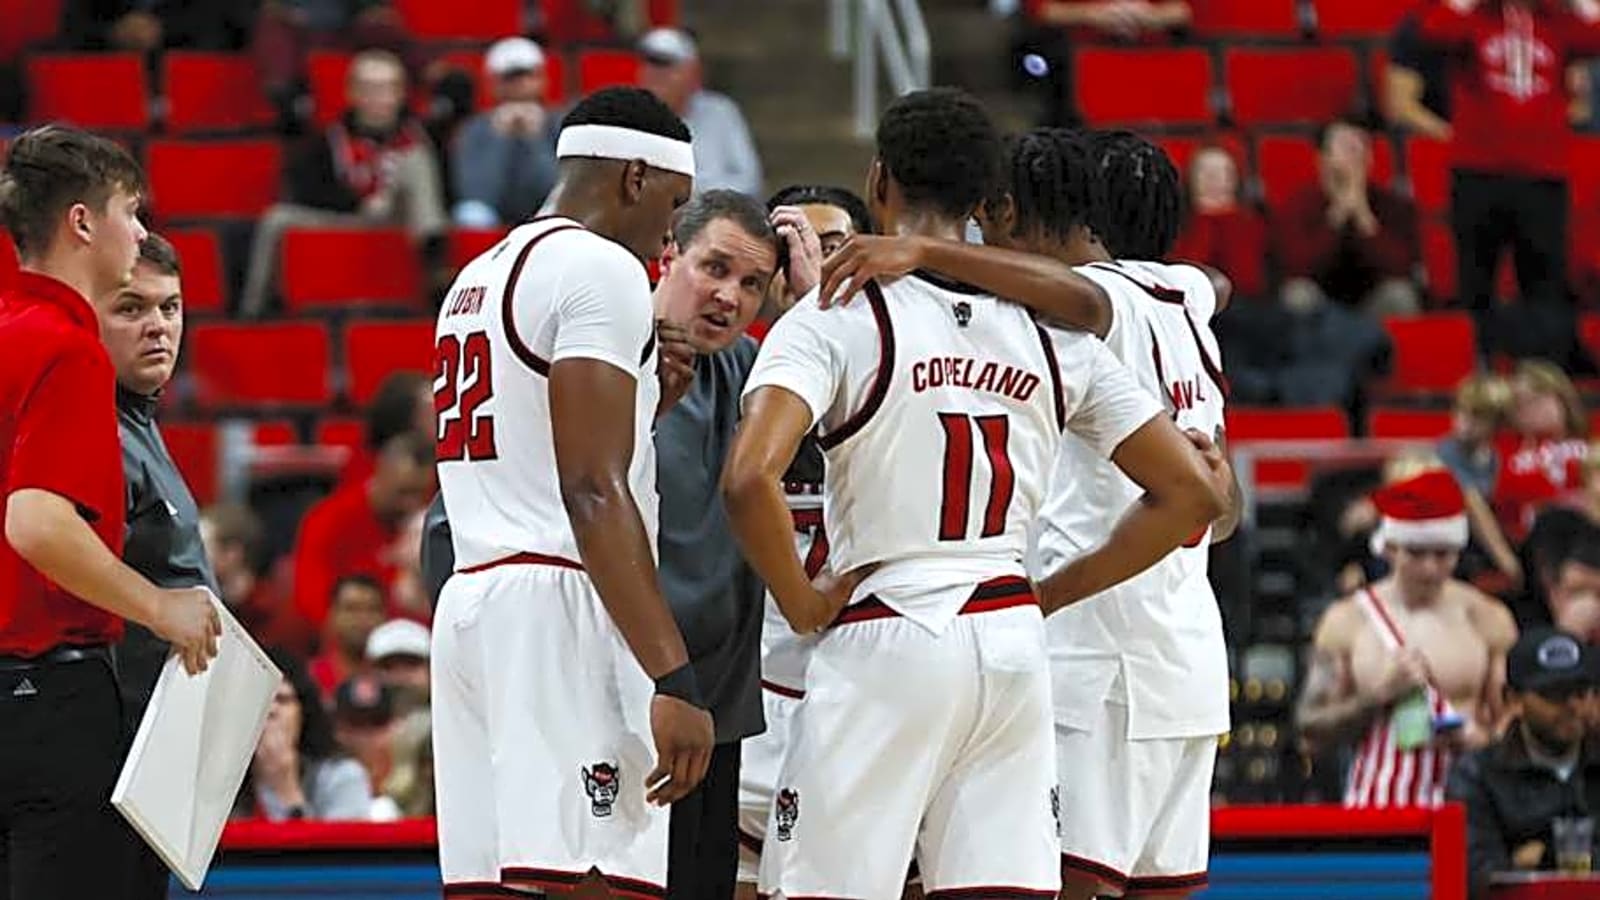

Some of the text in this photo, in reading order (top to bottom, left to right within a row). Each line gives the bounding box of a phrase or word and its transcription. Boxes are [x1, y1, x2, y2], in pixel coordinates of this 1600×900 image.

[434, 329, 498, 462] 22
[912, 356, 1041, 402] COPELAND
[936, 411, 1016, 541] 11
